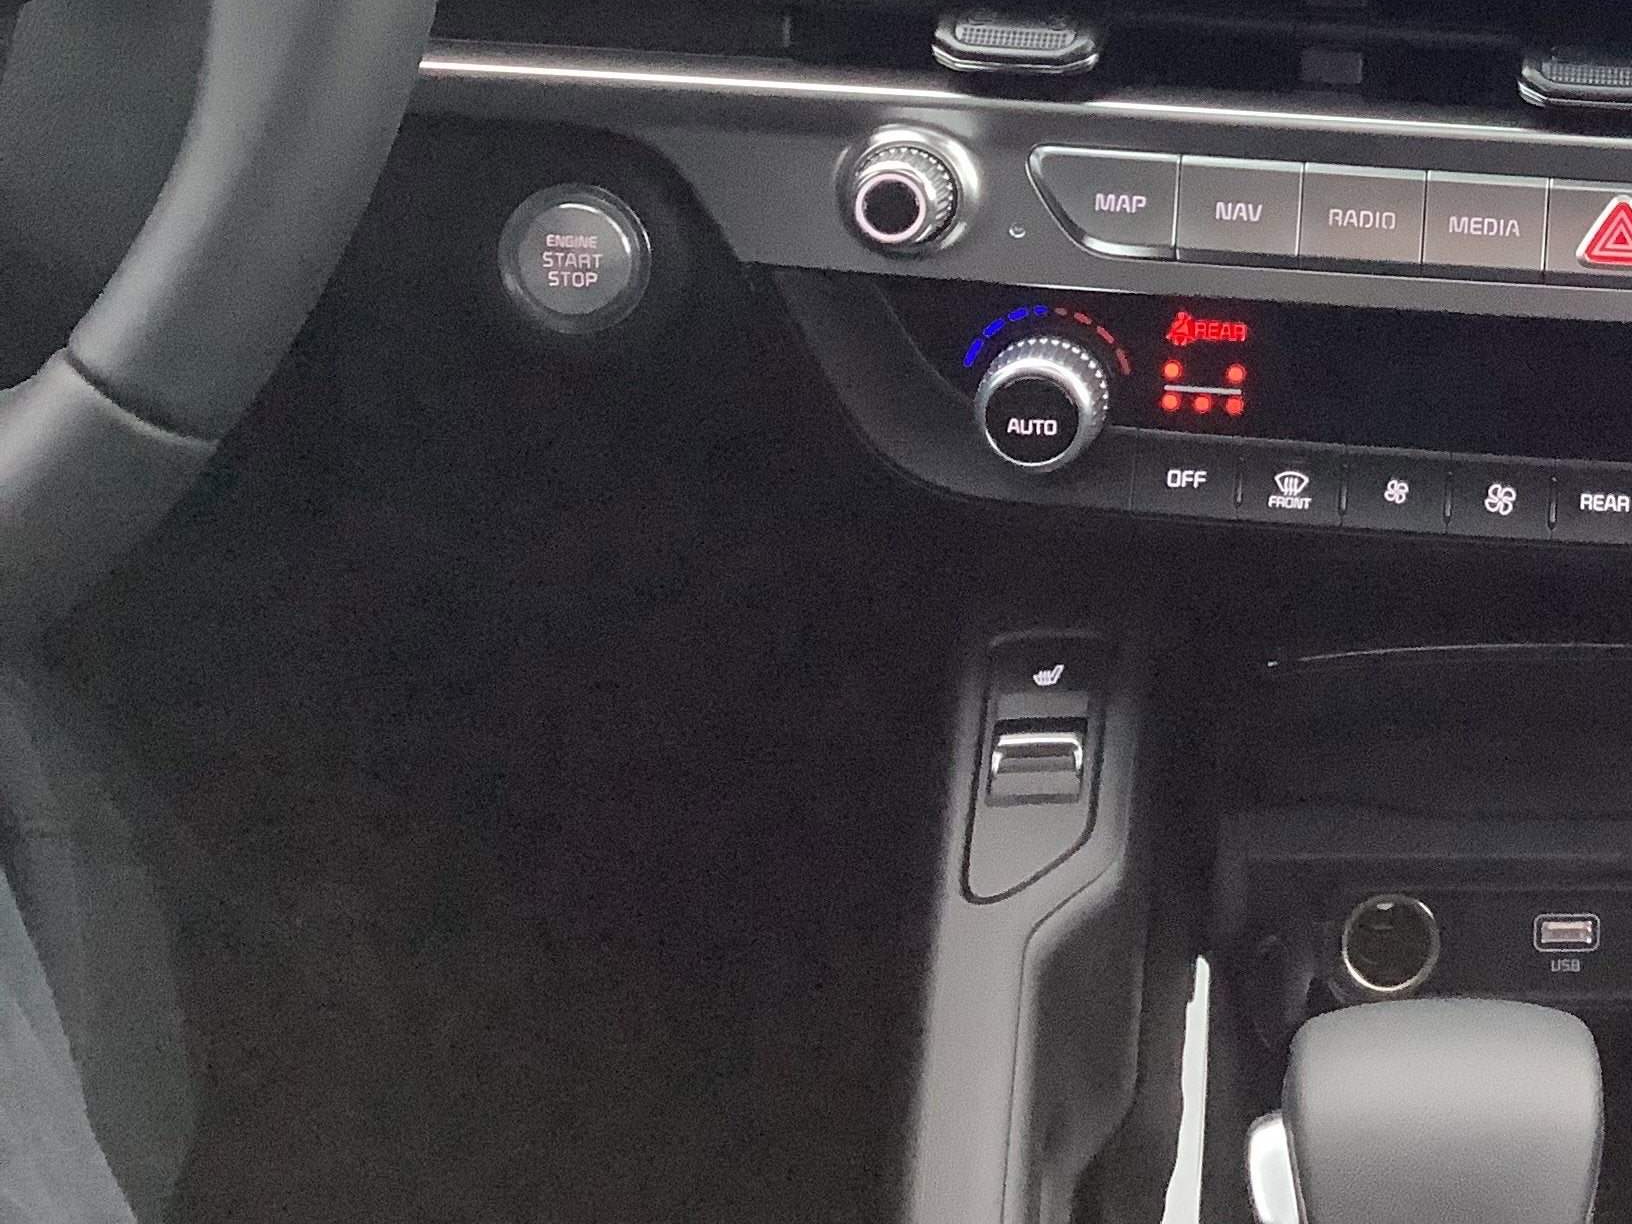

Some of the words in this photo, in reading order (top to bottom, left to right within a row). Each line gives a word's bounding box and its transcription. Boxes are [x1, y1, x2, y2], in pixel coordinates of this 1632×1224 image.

[1094, 192, 1147, 214] MAP
[1214, 200, 1263, 222] NAV
[1328, 207, 1397, 230] RADIO
[1448, 215, 1521, 238] MEDIA
[546, 233, 598, 249] ENGINE
[542, 251, 603, 269] START
[548, 270, 599, 288] STOP
[1194, 320, 1247, 341] REAR
[1007, 417, 1058, 438] AUTO
[1166, 468, 1207, 489] OFF
[1267, 493, 1313, 511] FRONT
[1579, 492, 1631, 514] REAR
[1550, 959, 1581, 973] USB
